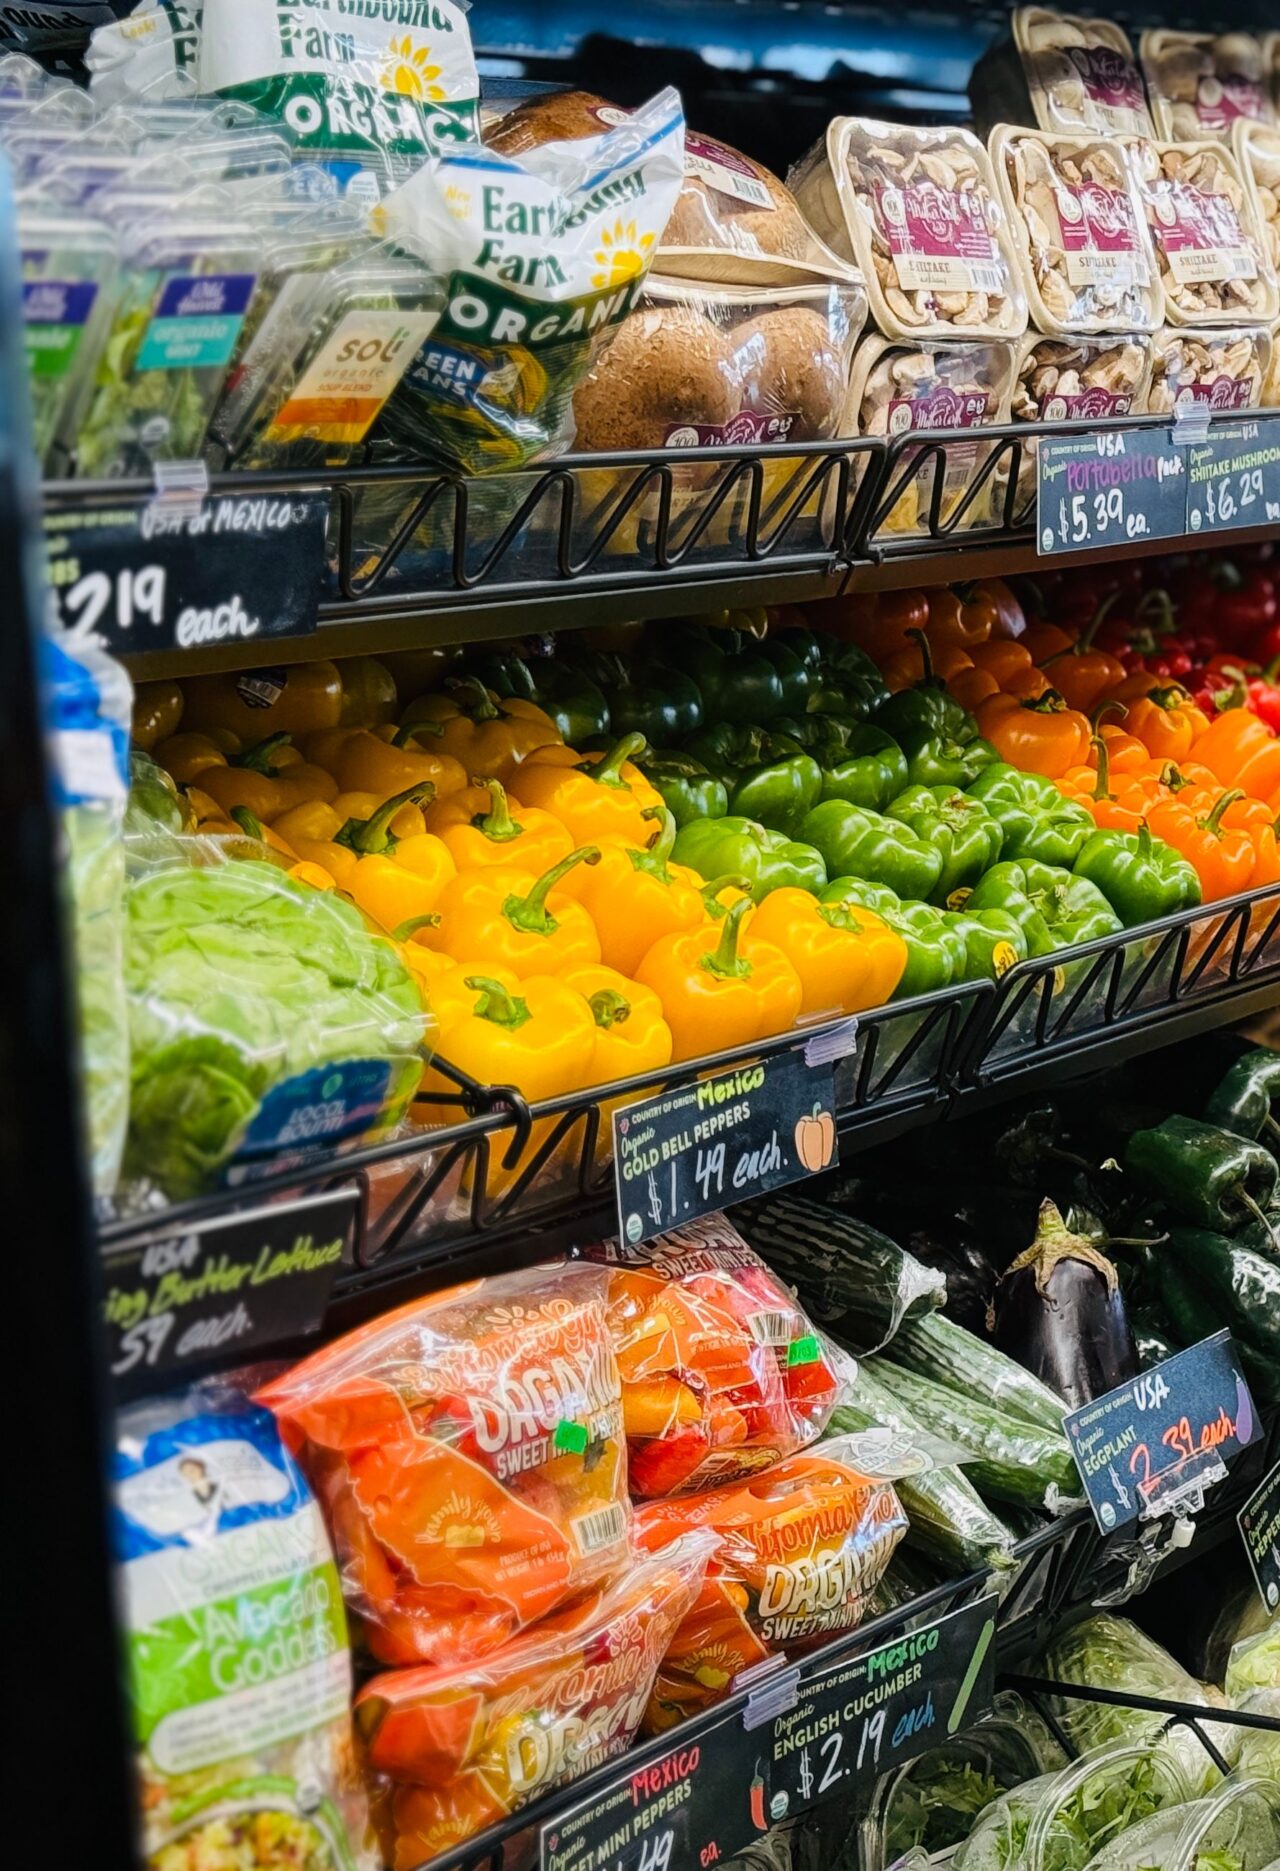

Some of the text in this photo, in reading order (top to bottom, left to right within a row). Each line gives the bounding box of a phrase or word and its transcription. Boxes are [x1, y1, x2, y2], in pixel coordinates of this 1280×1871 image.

[0, 6, 96, 40] ound
[276, 13, 356, 64] Farm
[285, 96, 456, 148] ORGANC
[404, 366, 468, 398] ANS
[412, 347, 477, 381] REEN
[1097, 433, 1126, 457] USA
[1242, 422, 1259, 441] USA
[213, 498, 293, 534] MEXICO
[176, 594, 260, 649] each
[632, 1105, 662, 1125] COUNTRY
[662, 1102, 673, 1113] OF
[696, 1066, 766, 1111] Mexico
[621, 1124, 656, 1159] Organic
[622, 1100, 751, 1181] GOLD BELL PEPPERS
[651, 1251, 709, 1282] SWEET
[1079, 1407, 1104, 1427] COUNTRY
[1104, 1402, 1113, 1413] OF
[1133, 1374, 1170, 1411] USA
[496, 1439, 551, 1480] SWEET
[1076, 1426, 1105, 1458] Organic
[1083, 1424, 1138, 1478] EGGPLANT
[760, 1612, 816, 1643] SWEET
[795, 1629, 940, 1701] OUNTRY OF ORIGIN: Mexico
[774, 1662, 923, 1762] ENGLISH CUCUMBER
[774, 1702, 816, 1739] Organic
[797, 1709, 886, 1801] $2.19
[561, 1810, 595, 1839] COUNTRY
[595, 1804, 606, 1818] OF
[630, 1746, 701, 1808] Mexico
[597, 1823, 631, 1866] MINI
[633, 1777, 693, 1837] PEPPERS
